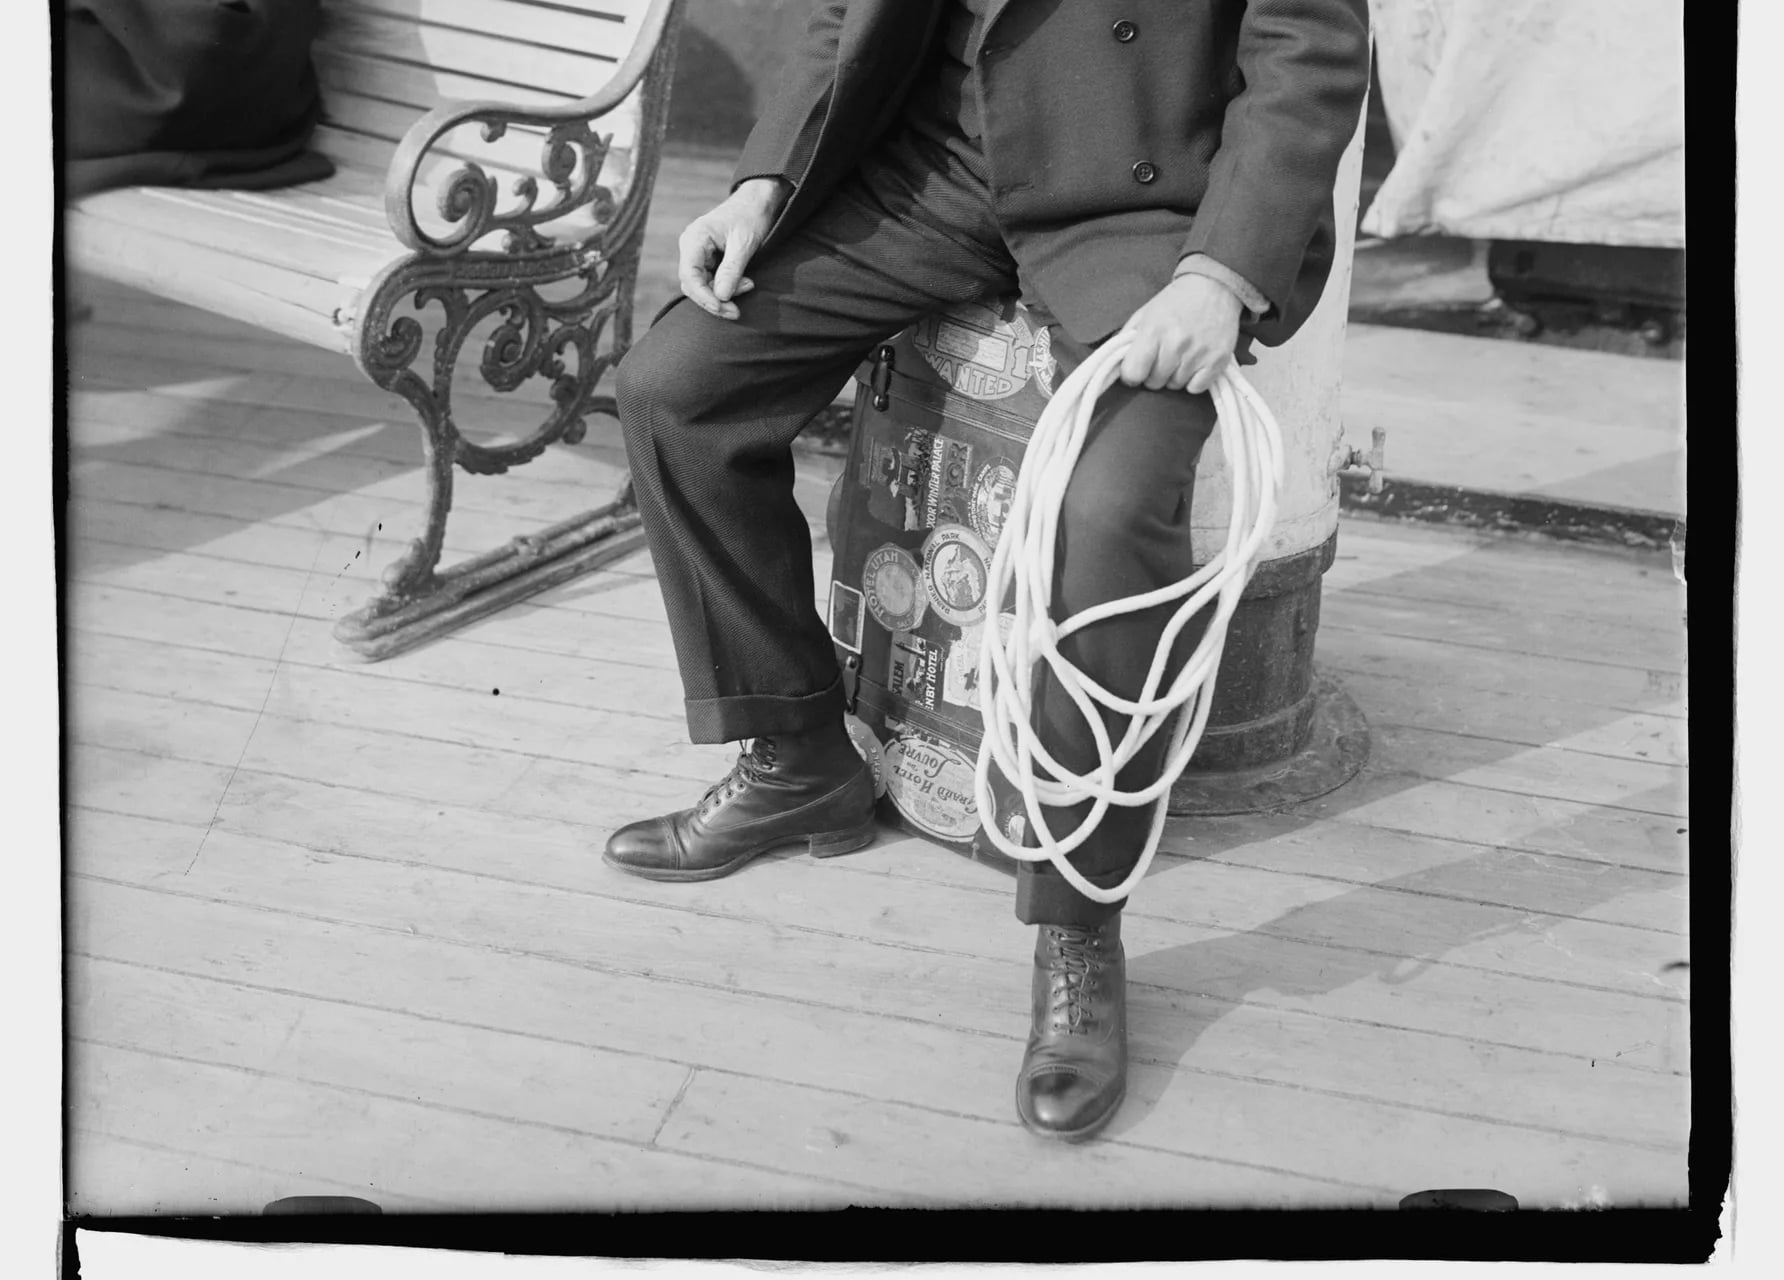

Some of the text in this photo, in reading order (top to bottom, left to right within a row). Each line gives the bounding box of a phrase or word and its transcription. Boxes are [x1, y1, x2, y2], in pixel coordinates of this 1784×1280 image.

[923, 351, 1013, 396] WANTED
[926, 438, 944, 529] XOR WINTER PALACE
[925, 542, 941, 580] NATIONAL
[941, 532, 961, 542] PARK
[866, 550, 899, 617] HOTEL UTAH
[926, 649, 938, 683] HOTEL
[899, 742, 962, 779] LOUVRE
[937, 786, 979, 814] GRAND
